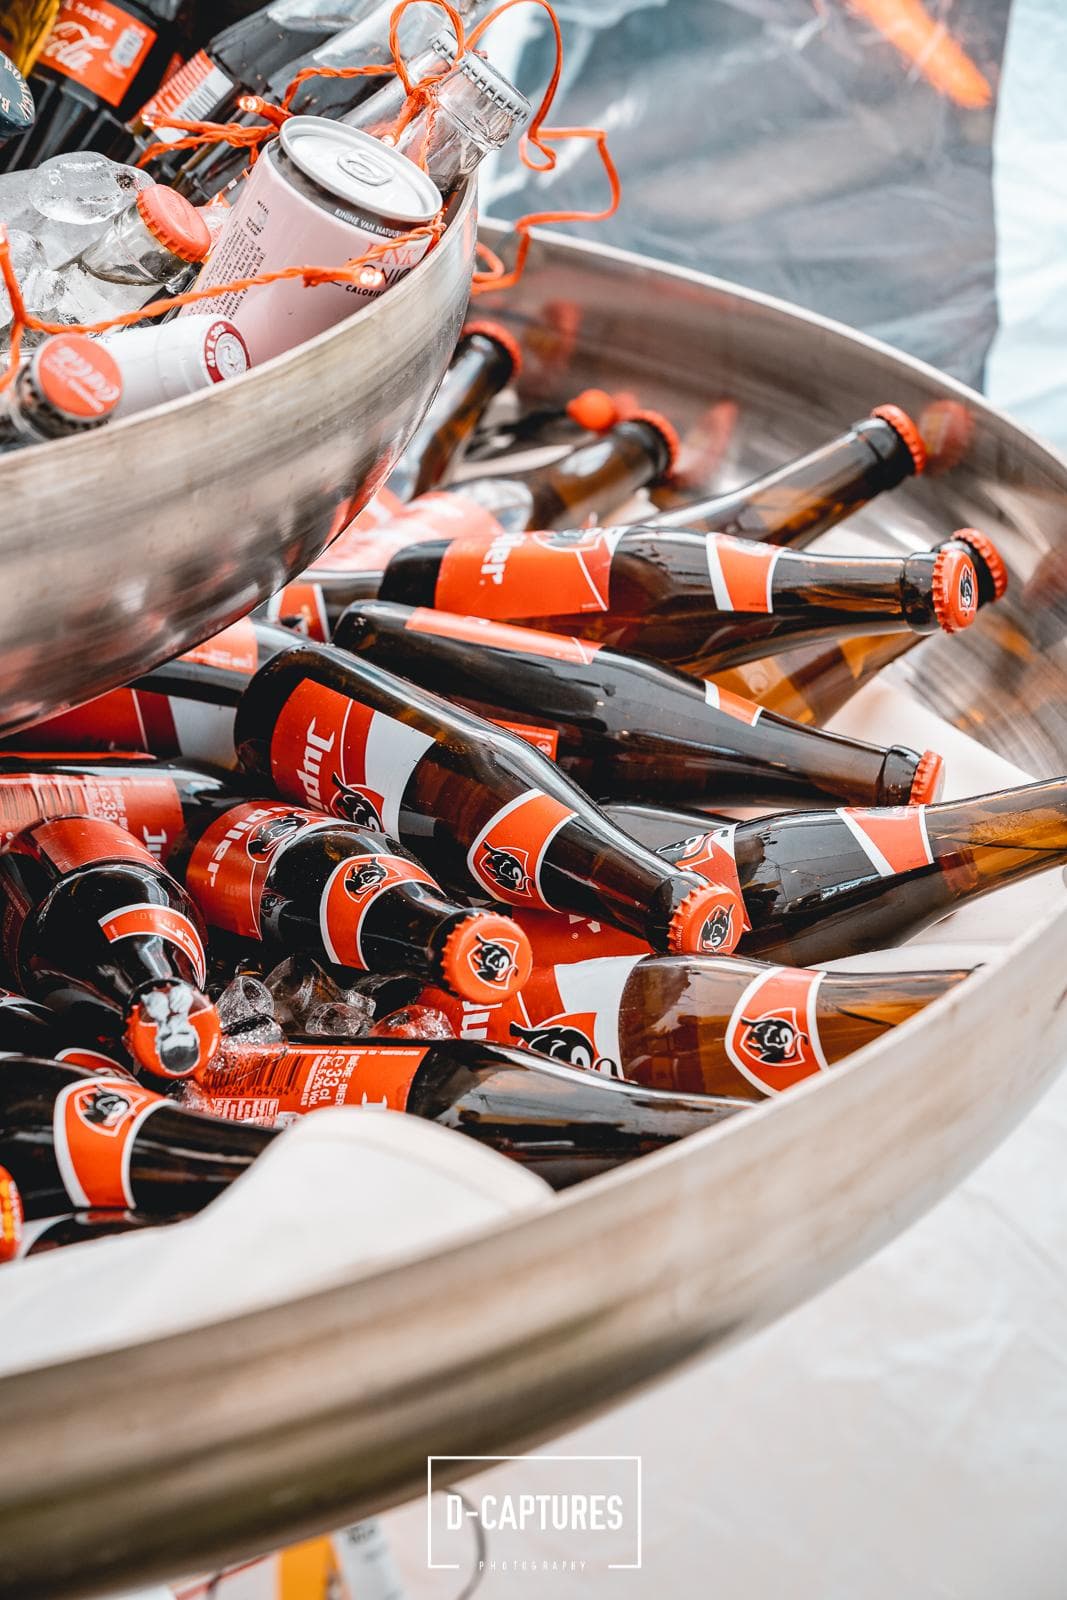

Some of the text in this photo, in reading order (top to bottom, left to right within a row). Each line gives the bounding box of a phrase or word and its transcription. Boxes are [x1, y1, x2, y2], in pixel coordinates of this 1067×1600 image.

[335, 208, 360, 226] KININE
[360, 219, 375, 232] VAN
[345, 285, 385, 298] CALORIE
[296, 717, 335, 813] Jupi
[323, 1068, 344, 1088] 33
[319, 1088, 332, 1101] cl
